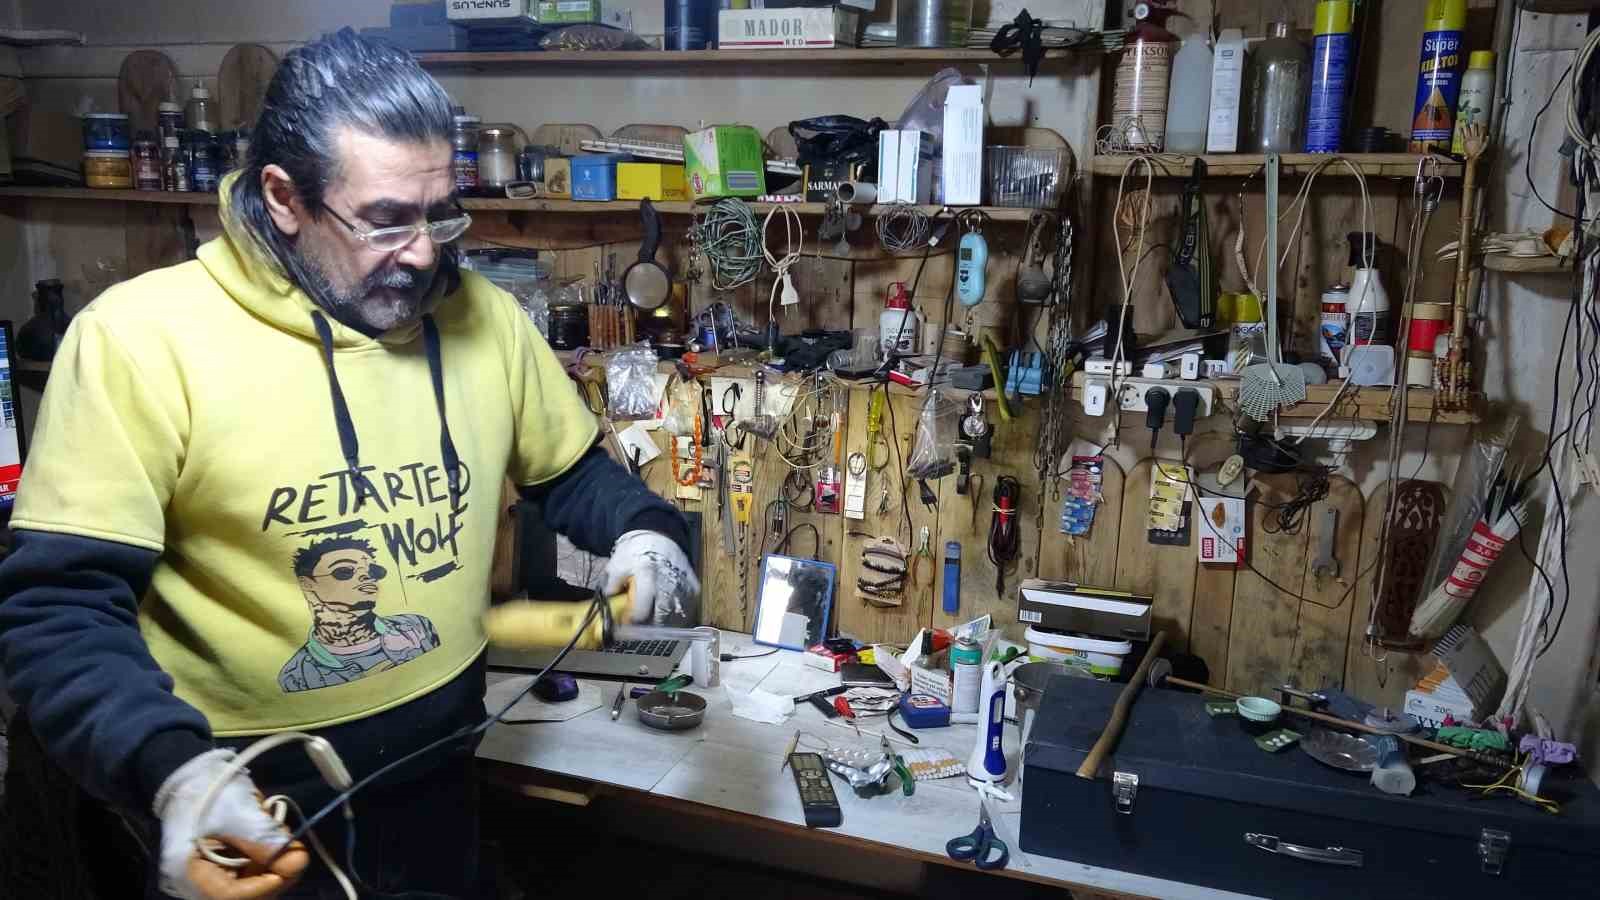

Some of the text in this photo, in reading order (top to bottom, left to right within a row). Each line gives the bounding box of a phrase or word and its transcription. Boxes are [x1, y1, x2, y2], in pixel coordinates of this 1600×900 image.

[452, 0, 511, 9] SUNPLUS
[744, 18, 803, 36] MADOR
[1424, 39, 1458, 52] Super
[807, 180, 841, 191] SARMA
[262, 460, 471, 532] RETARTED
[380, 502, 469, 566] WOLF
